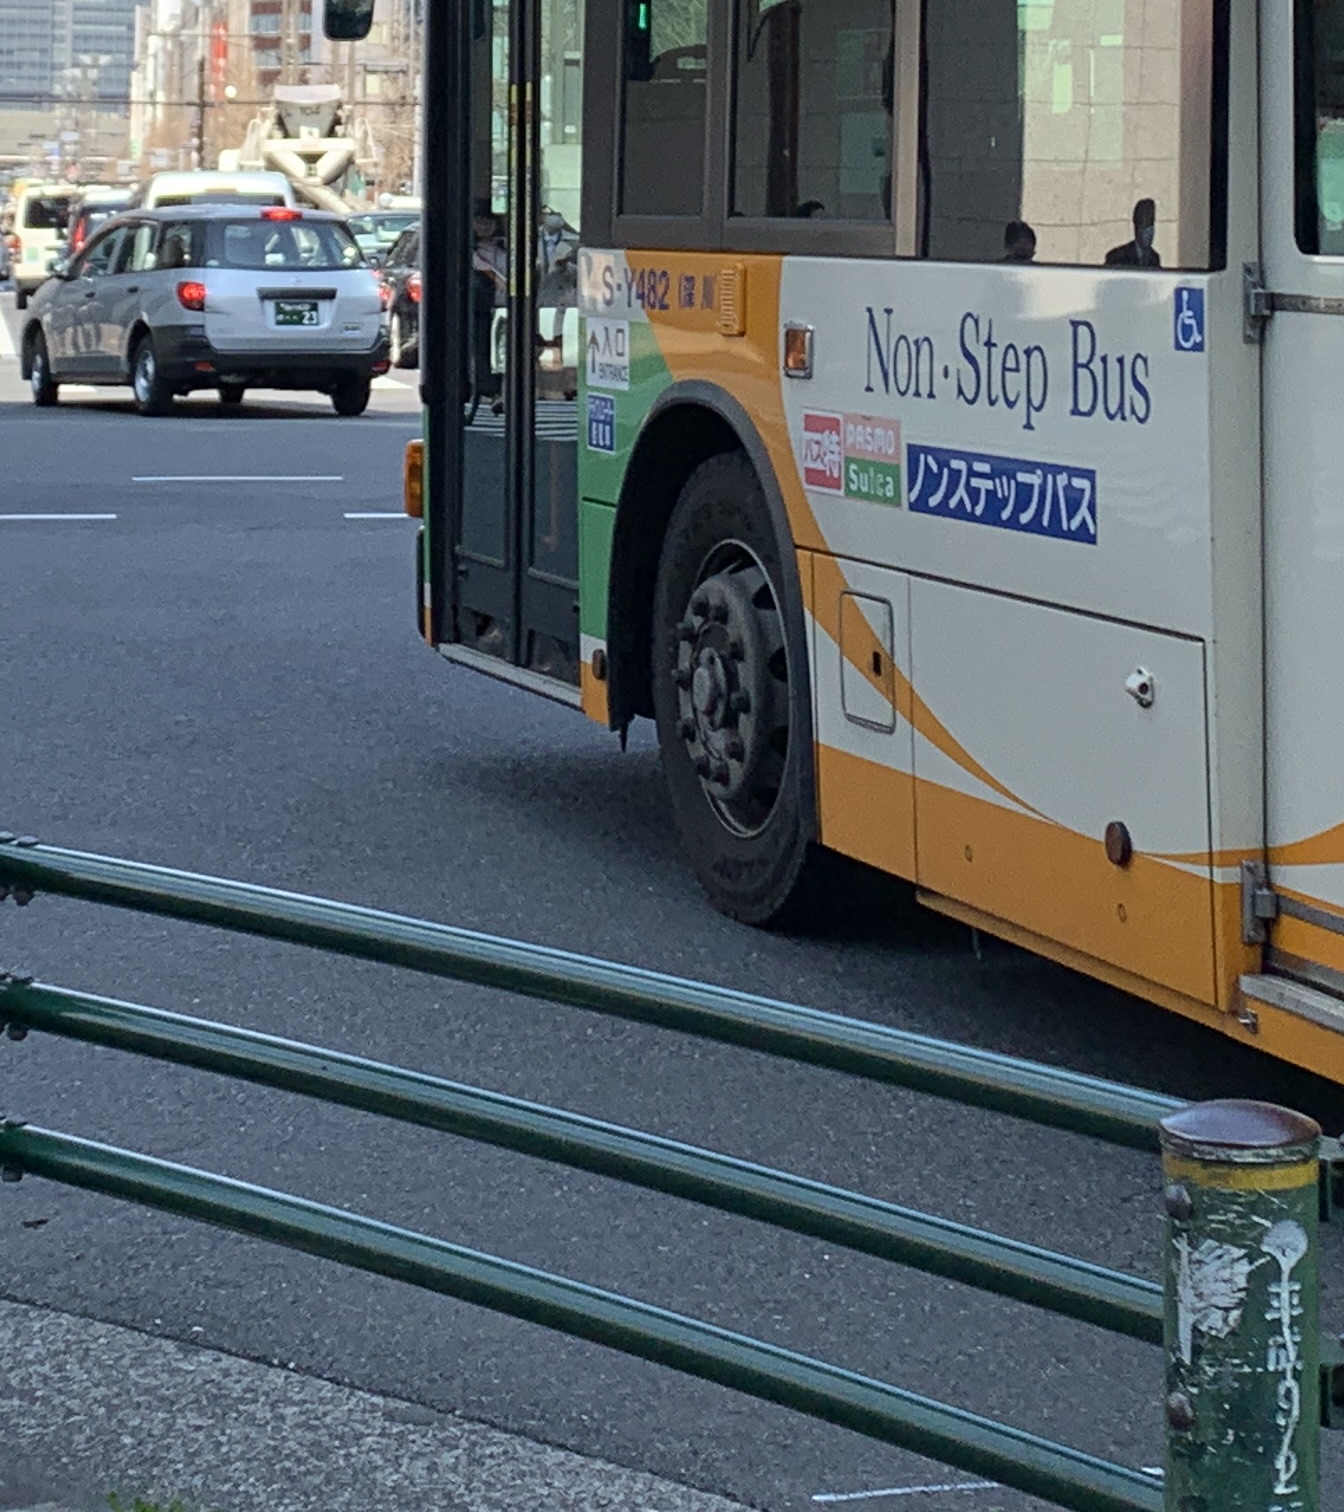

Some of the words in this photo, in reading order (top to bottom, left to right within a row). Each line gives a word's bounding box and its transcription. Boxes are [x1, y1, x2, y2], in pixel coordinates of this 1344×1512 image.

[602, 326, 625, 357] 入口
[598, 362, 629, 383] ENTRANCE
[1069, 319, 1152, 425] Bus
[845, 423, 896, 456] PASMO
[847, 461, 895, 499] Suica
[908, 452, 1097, 536] ノンステップバス
